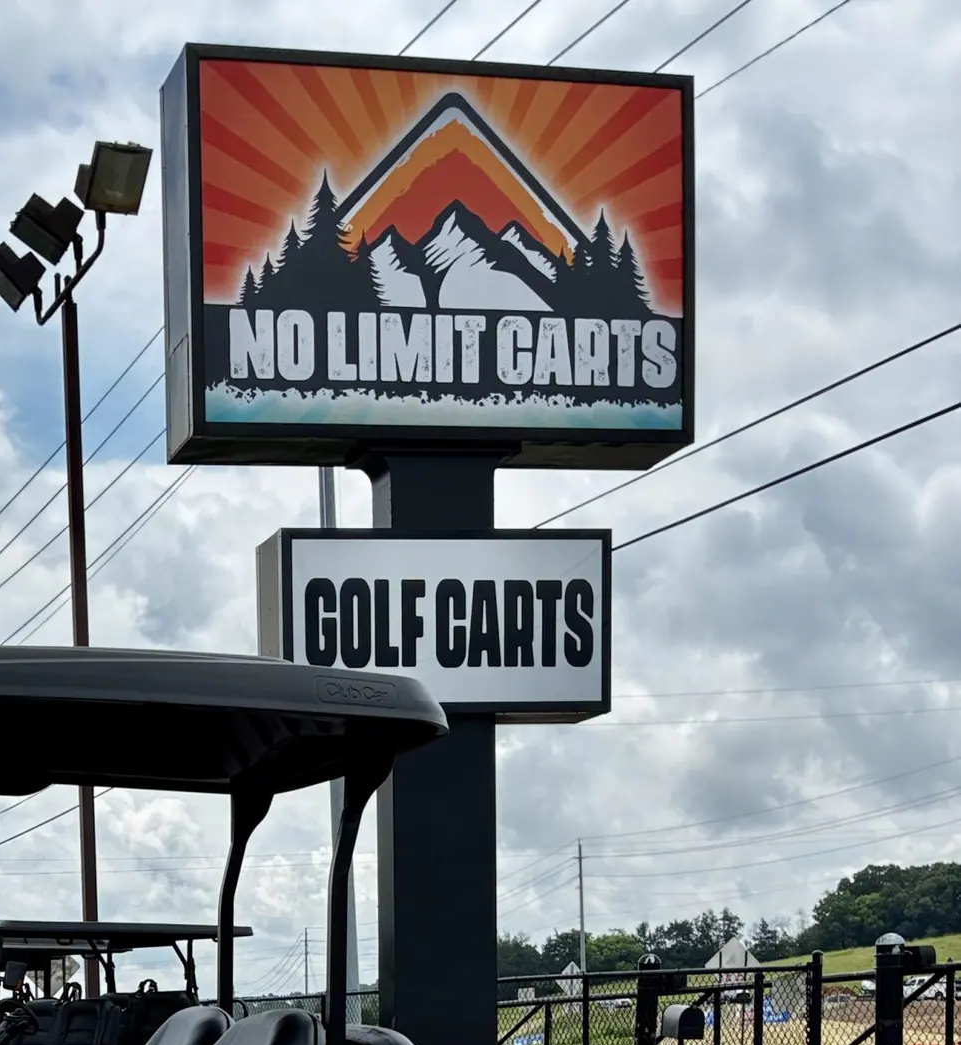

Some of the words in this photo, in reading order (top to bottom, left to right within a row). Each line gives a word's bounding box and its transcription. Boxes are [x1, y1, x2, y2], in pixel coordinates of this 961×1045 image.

[229, 308, 315, 381] NO
[326, 311, 486, 384] LIMIT
[496, 316, 677, 389] CARTS
[304, 577, 426, 668] GOLF
[435, 578, 594, 668] CARTS
